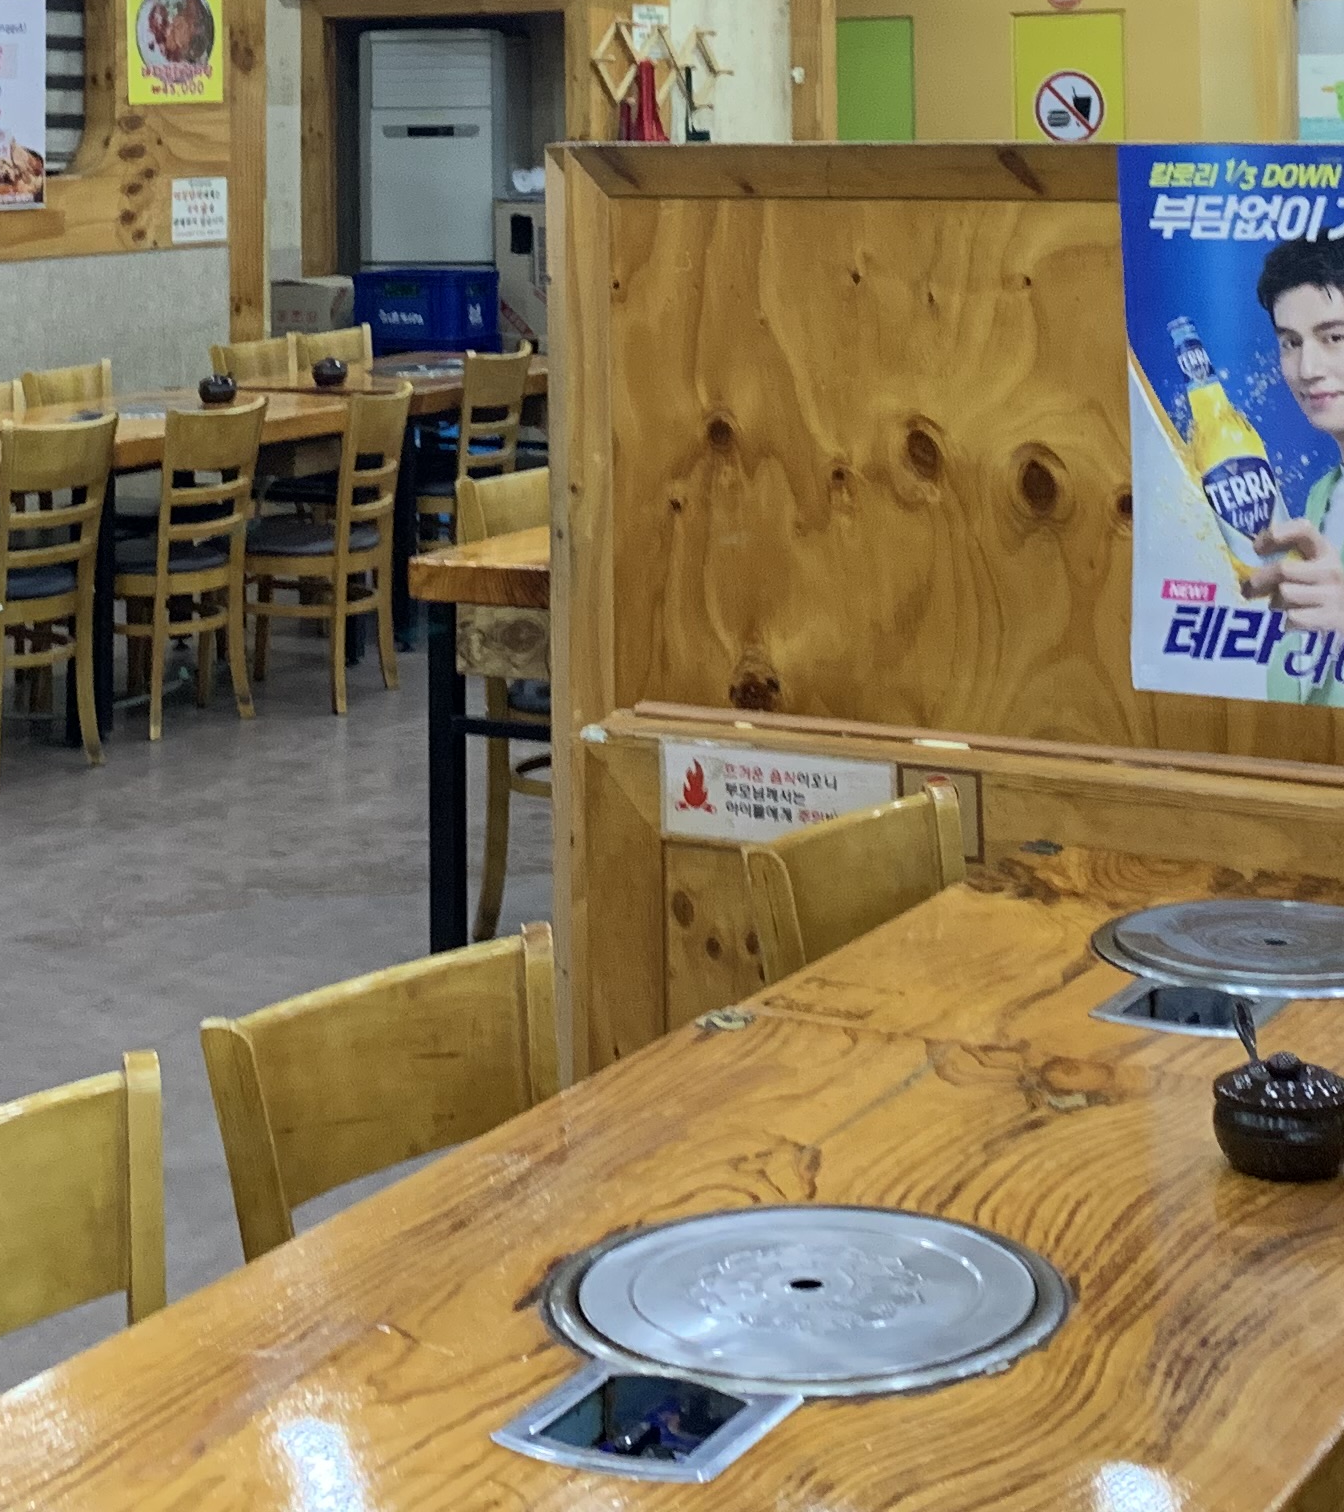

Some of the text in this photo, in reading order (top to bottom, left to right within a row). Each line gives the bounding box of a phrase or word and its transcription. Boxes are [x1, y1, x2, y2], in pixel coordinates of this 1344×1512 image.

[1149, 161, 1219, 188] 칼로리
[1262, 163, 1342, 189] DOWN
[1149, 193, 1328, 243] 부담없이
[1205, 466, 1277, 516] TERRA
[1163, 605, 1286, 665] 테라
[725, 763, 838, 792] 뜨거운 음식이오니
[725, 782, 806, 807] 부모님께서는
[725, 801, 793, 823] 아이들에게
